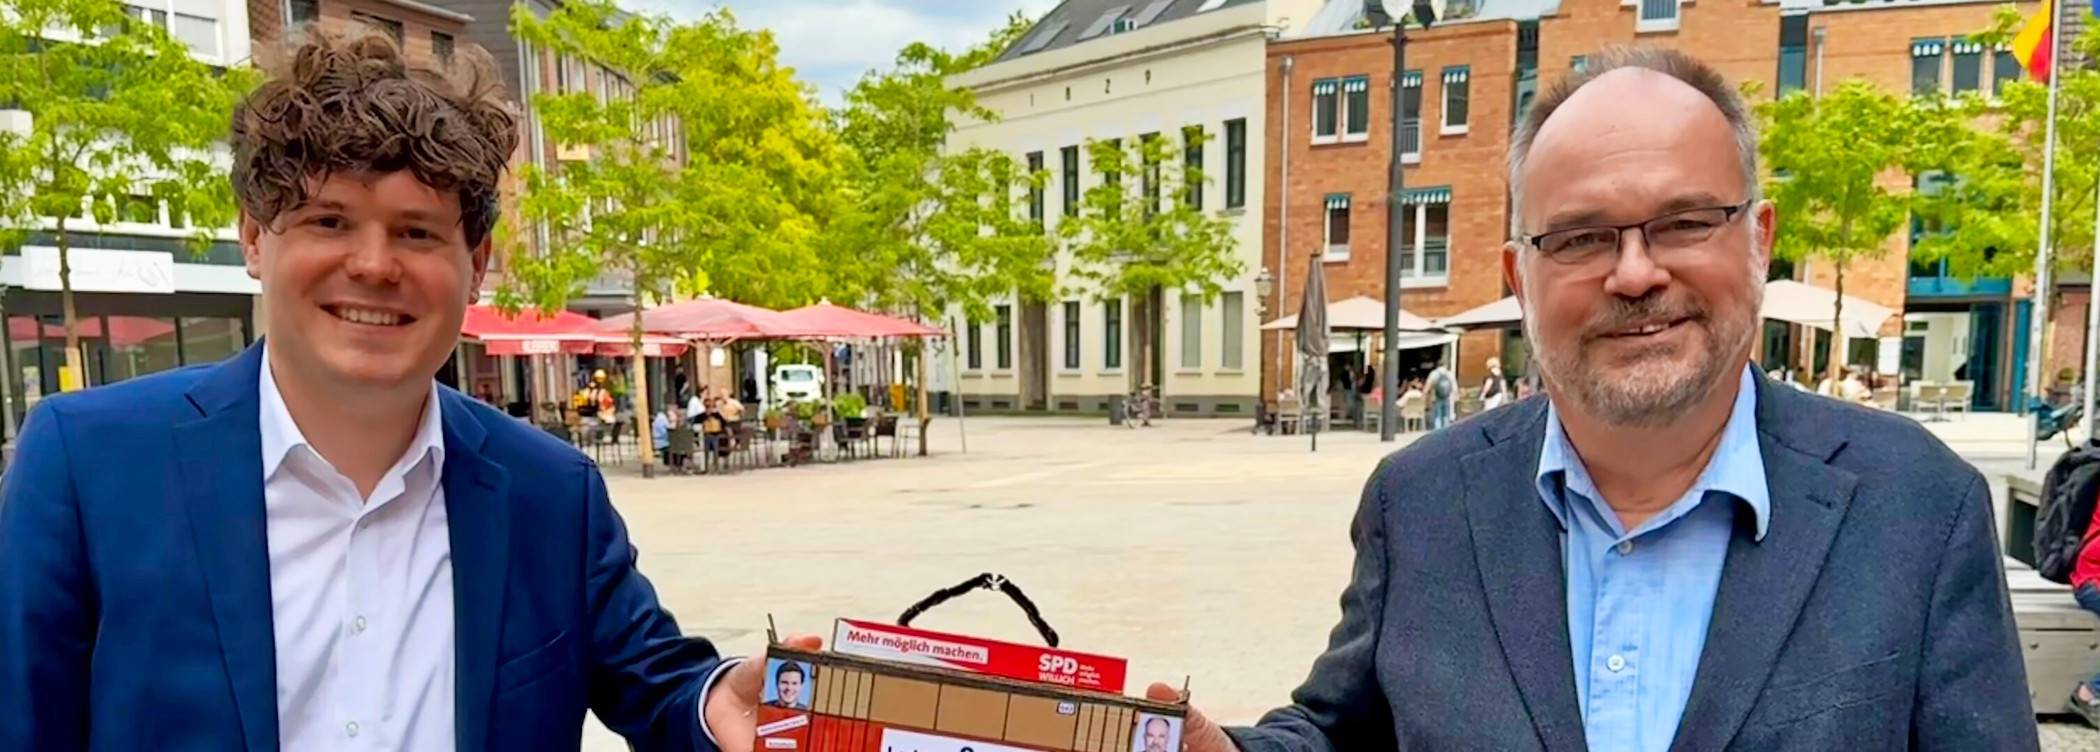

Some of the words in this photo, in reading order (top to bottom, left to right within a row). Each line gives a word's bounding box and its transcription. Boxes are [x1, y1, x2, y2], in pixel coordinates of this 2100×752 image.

[847, 630, 880, 645] Mehr
[882, 636, 930, 654] möglich
[932, 646, 984, 661] machen.
[1038, 653, 1078, 675] SPD
[1038, 671, 1075, 685] WILLICH
